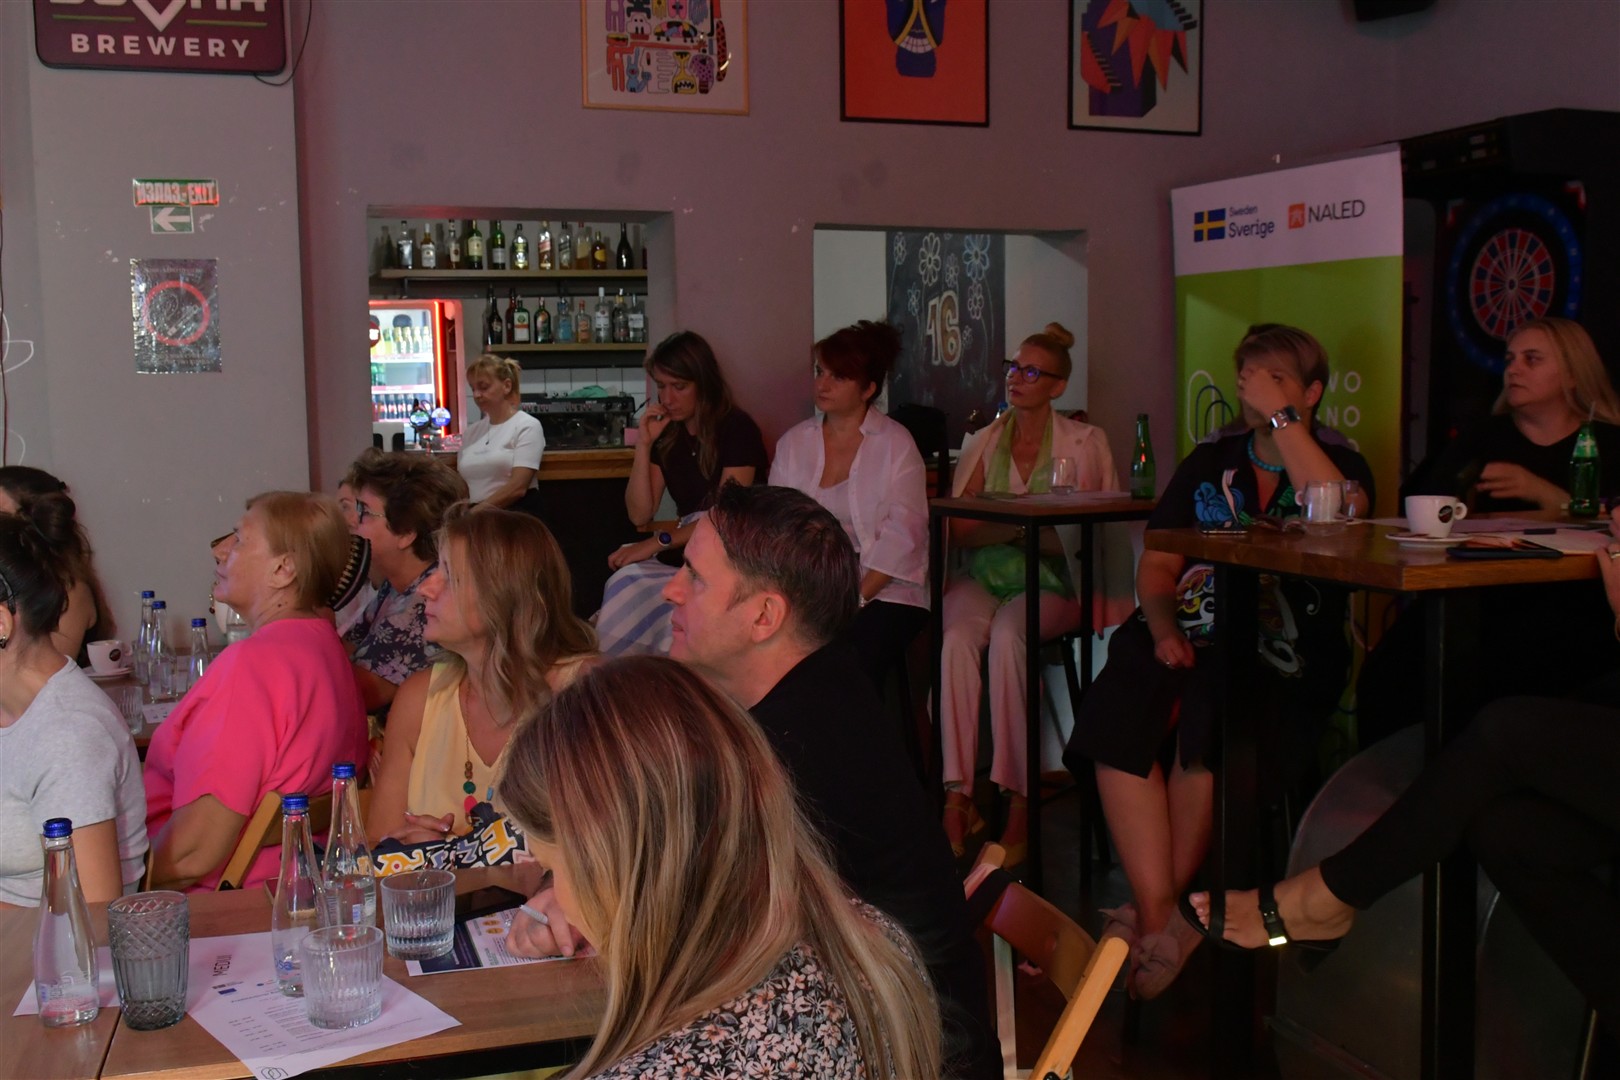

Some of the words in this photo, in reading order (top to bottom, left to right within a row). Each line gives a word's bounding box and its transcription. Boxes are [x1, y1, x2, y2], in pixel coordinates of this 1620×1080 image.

[71, 33, 250, 58] BREWERY
[1229, 205, 1257, 217] Sweden
[1308, 199, 1365, 223] NALED
[1228, 219, 1275, 239] Sverige
[925, 290, 962, 367] 16
[1316, 405, 1361, 428] NO
